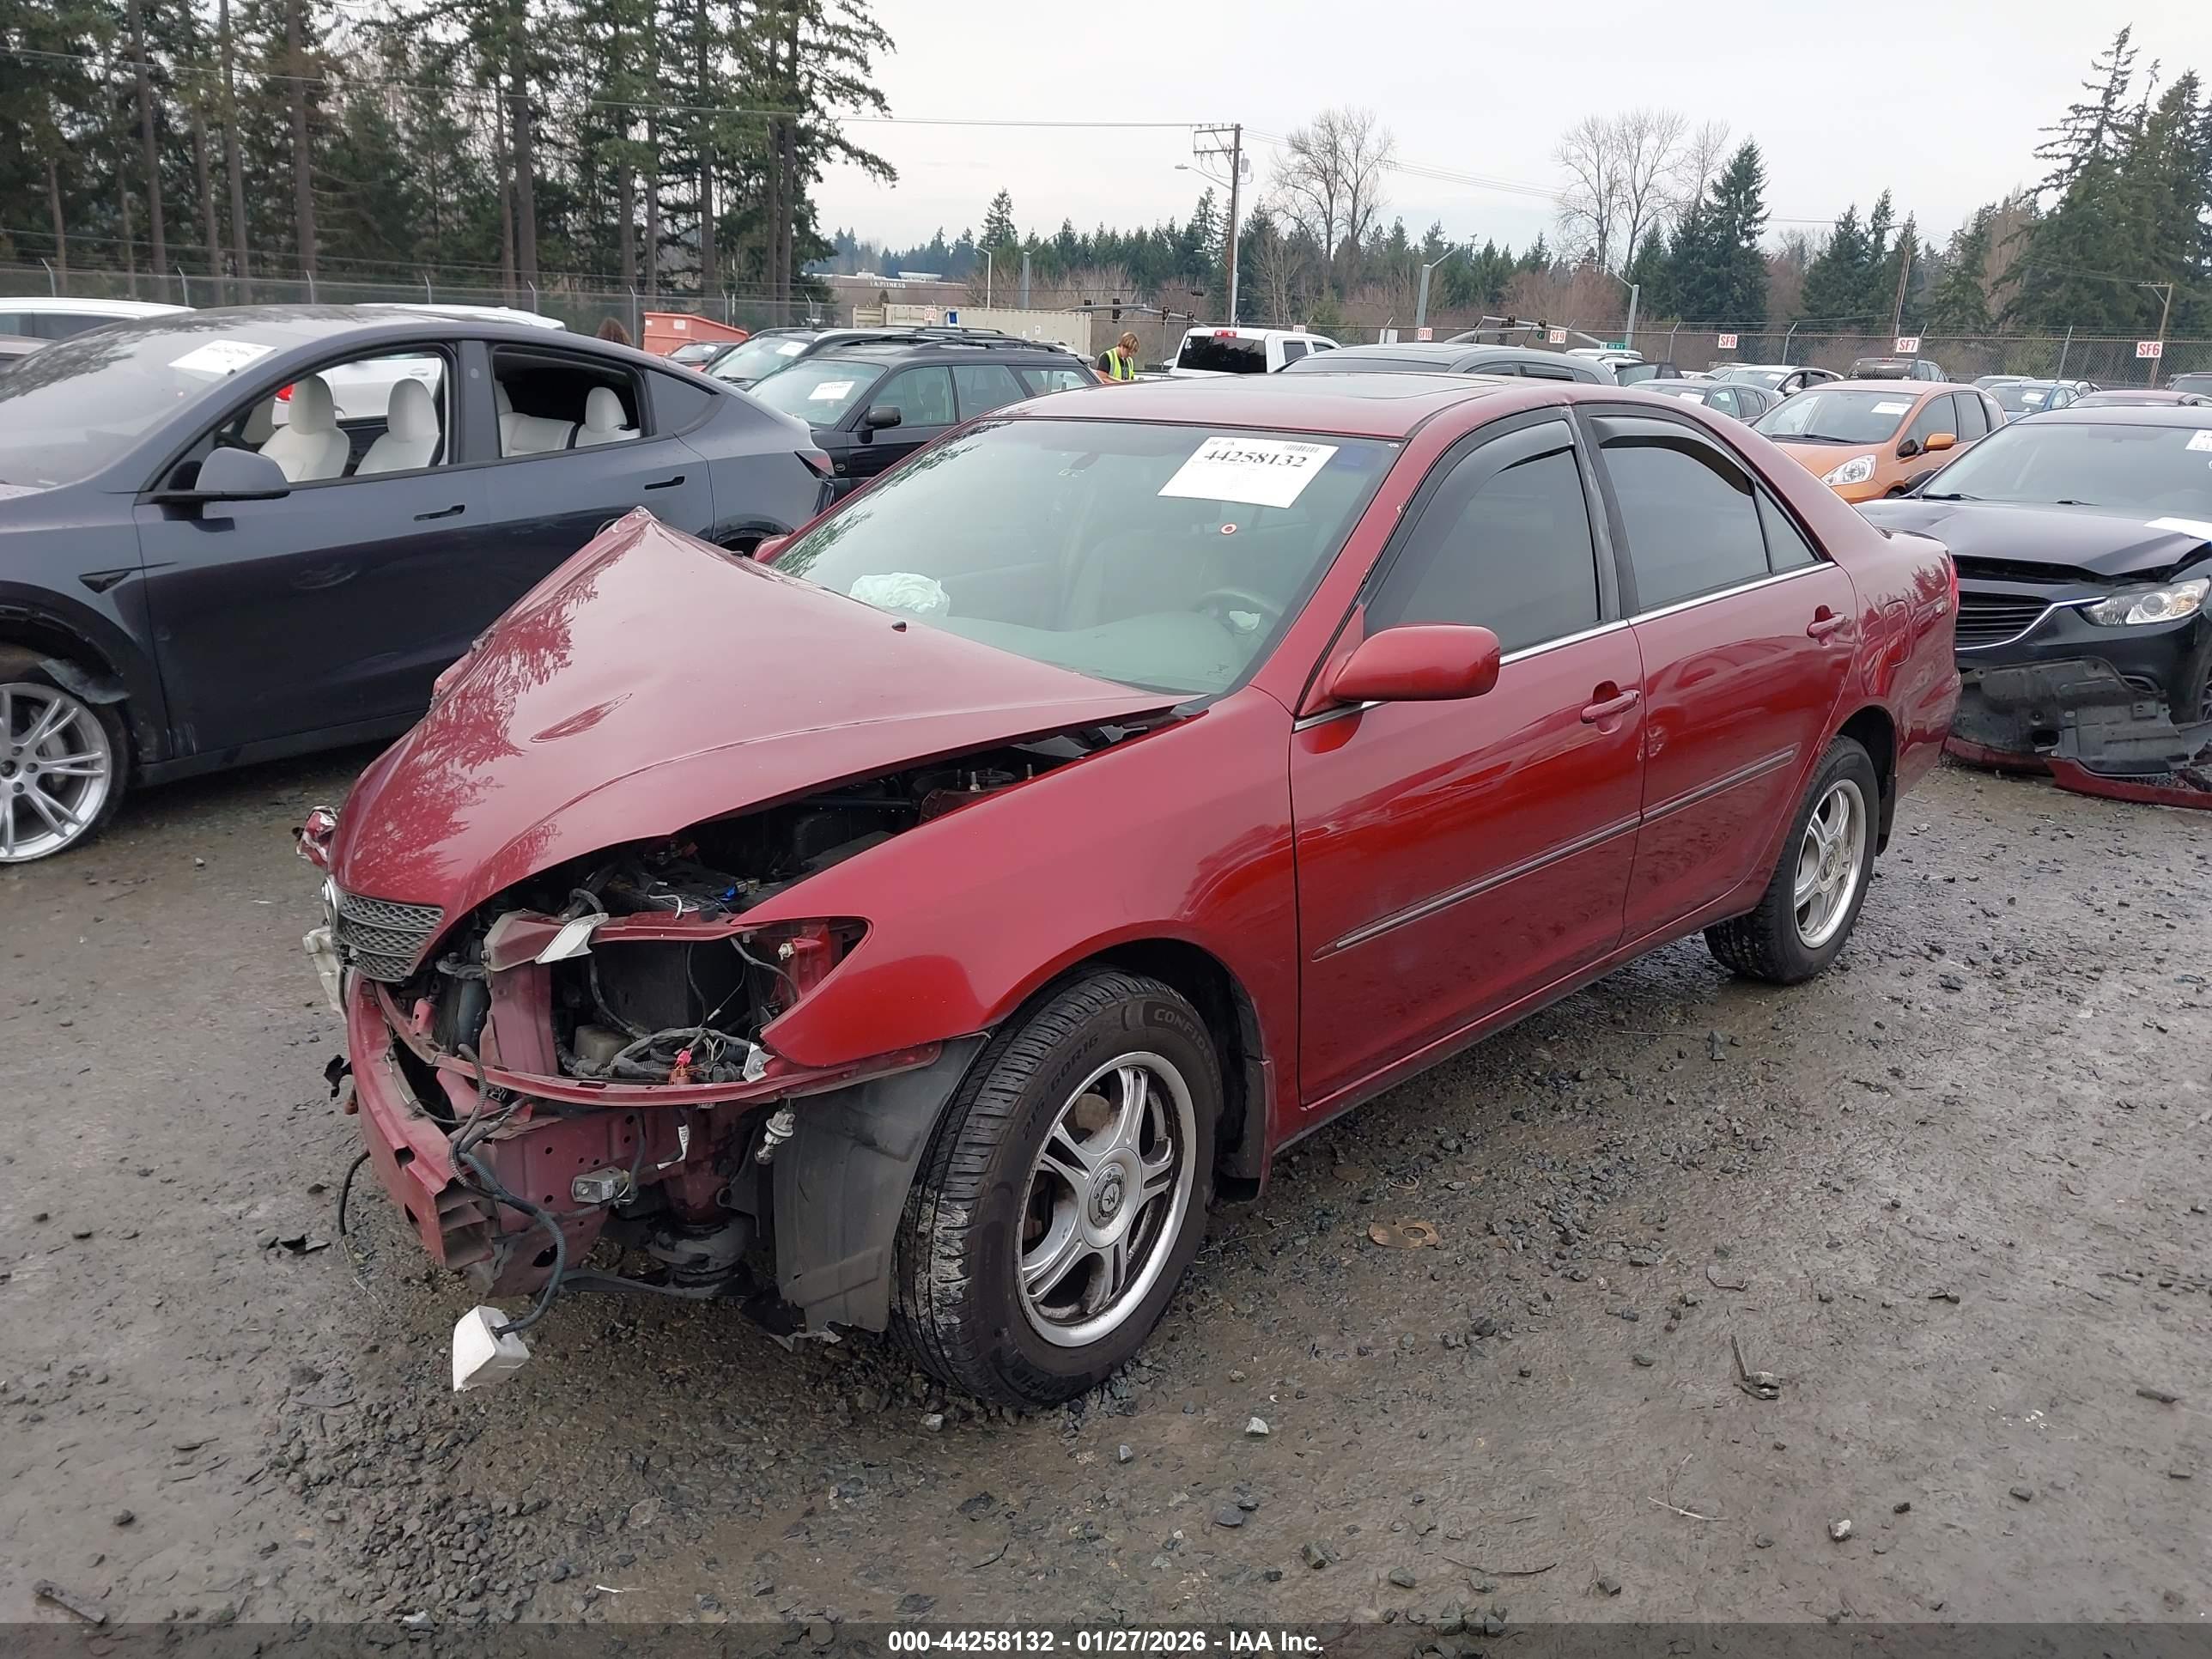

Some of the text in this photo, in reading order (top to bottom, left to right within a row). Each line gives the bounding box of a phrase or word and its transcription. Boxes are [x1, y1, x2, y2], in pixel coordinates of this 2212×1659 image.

[1551, 331, 1565, 342] SF9
[1720, 335, 1735, 347] SF8
[1899, 339, 1917, 351] SF7
[2138, 343, 2160, 356] SF6
[1204, 450, 1308, 468] 44258132
